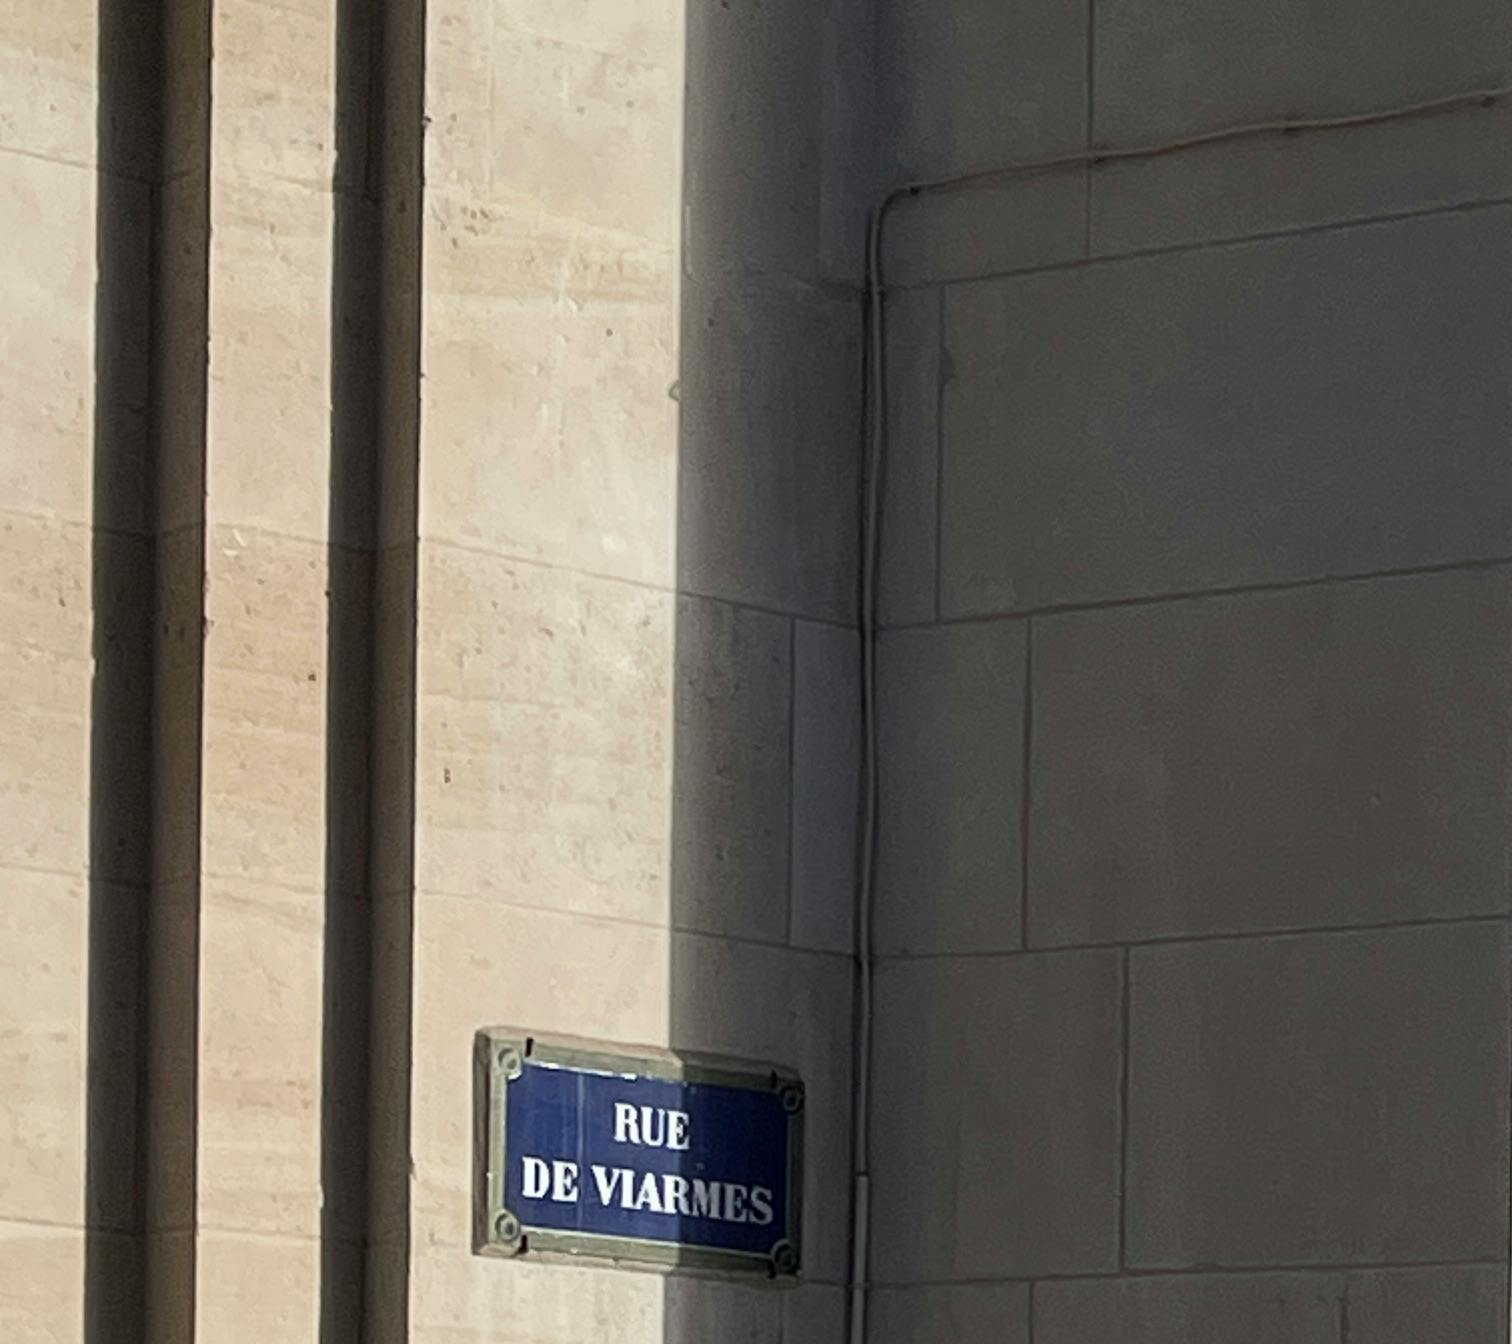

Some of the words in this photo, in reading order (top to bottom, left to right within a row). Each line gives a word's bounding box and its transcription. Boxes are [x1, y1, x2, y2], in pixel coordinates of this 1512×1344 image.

[613, 1102, 690, 1150] RUE
[521, 1156, 578, 1202] DE
[591, 1165, 774, 1226] VIARMES
